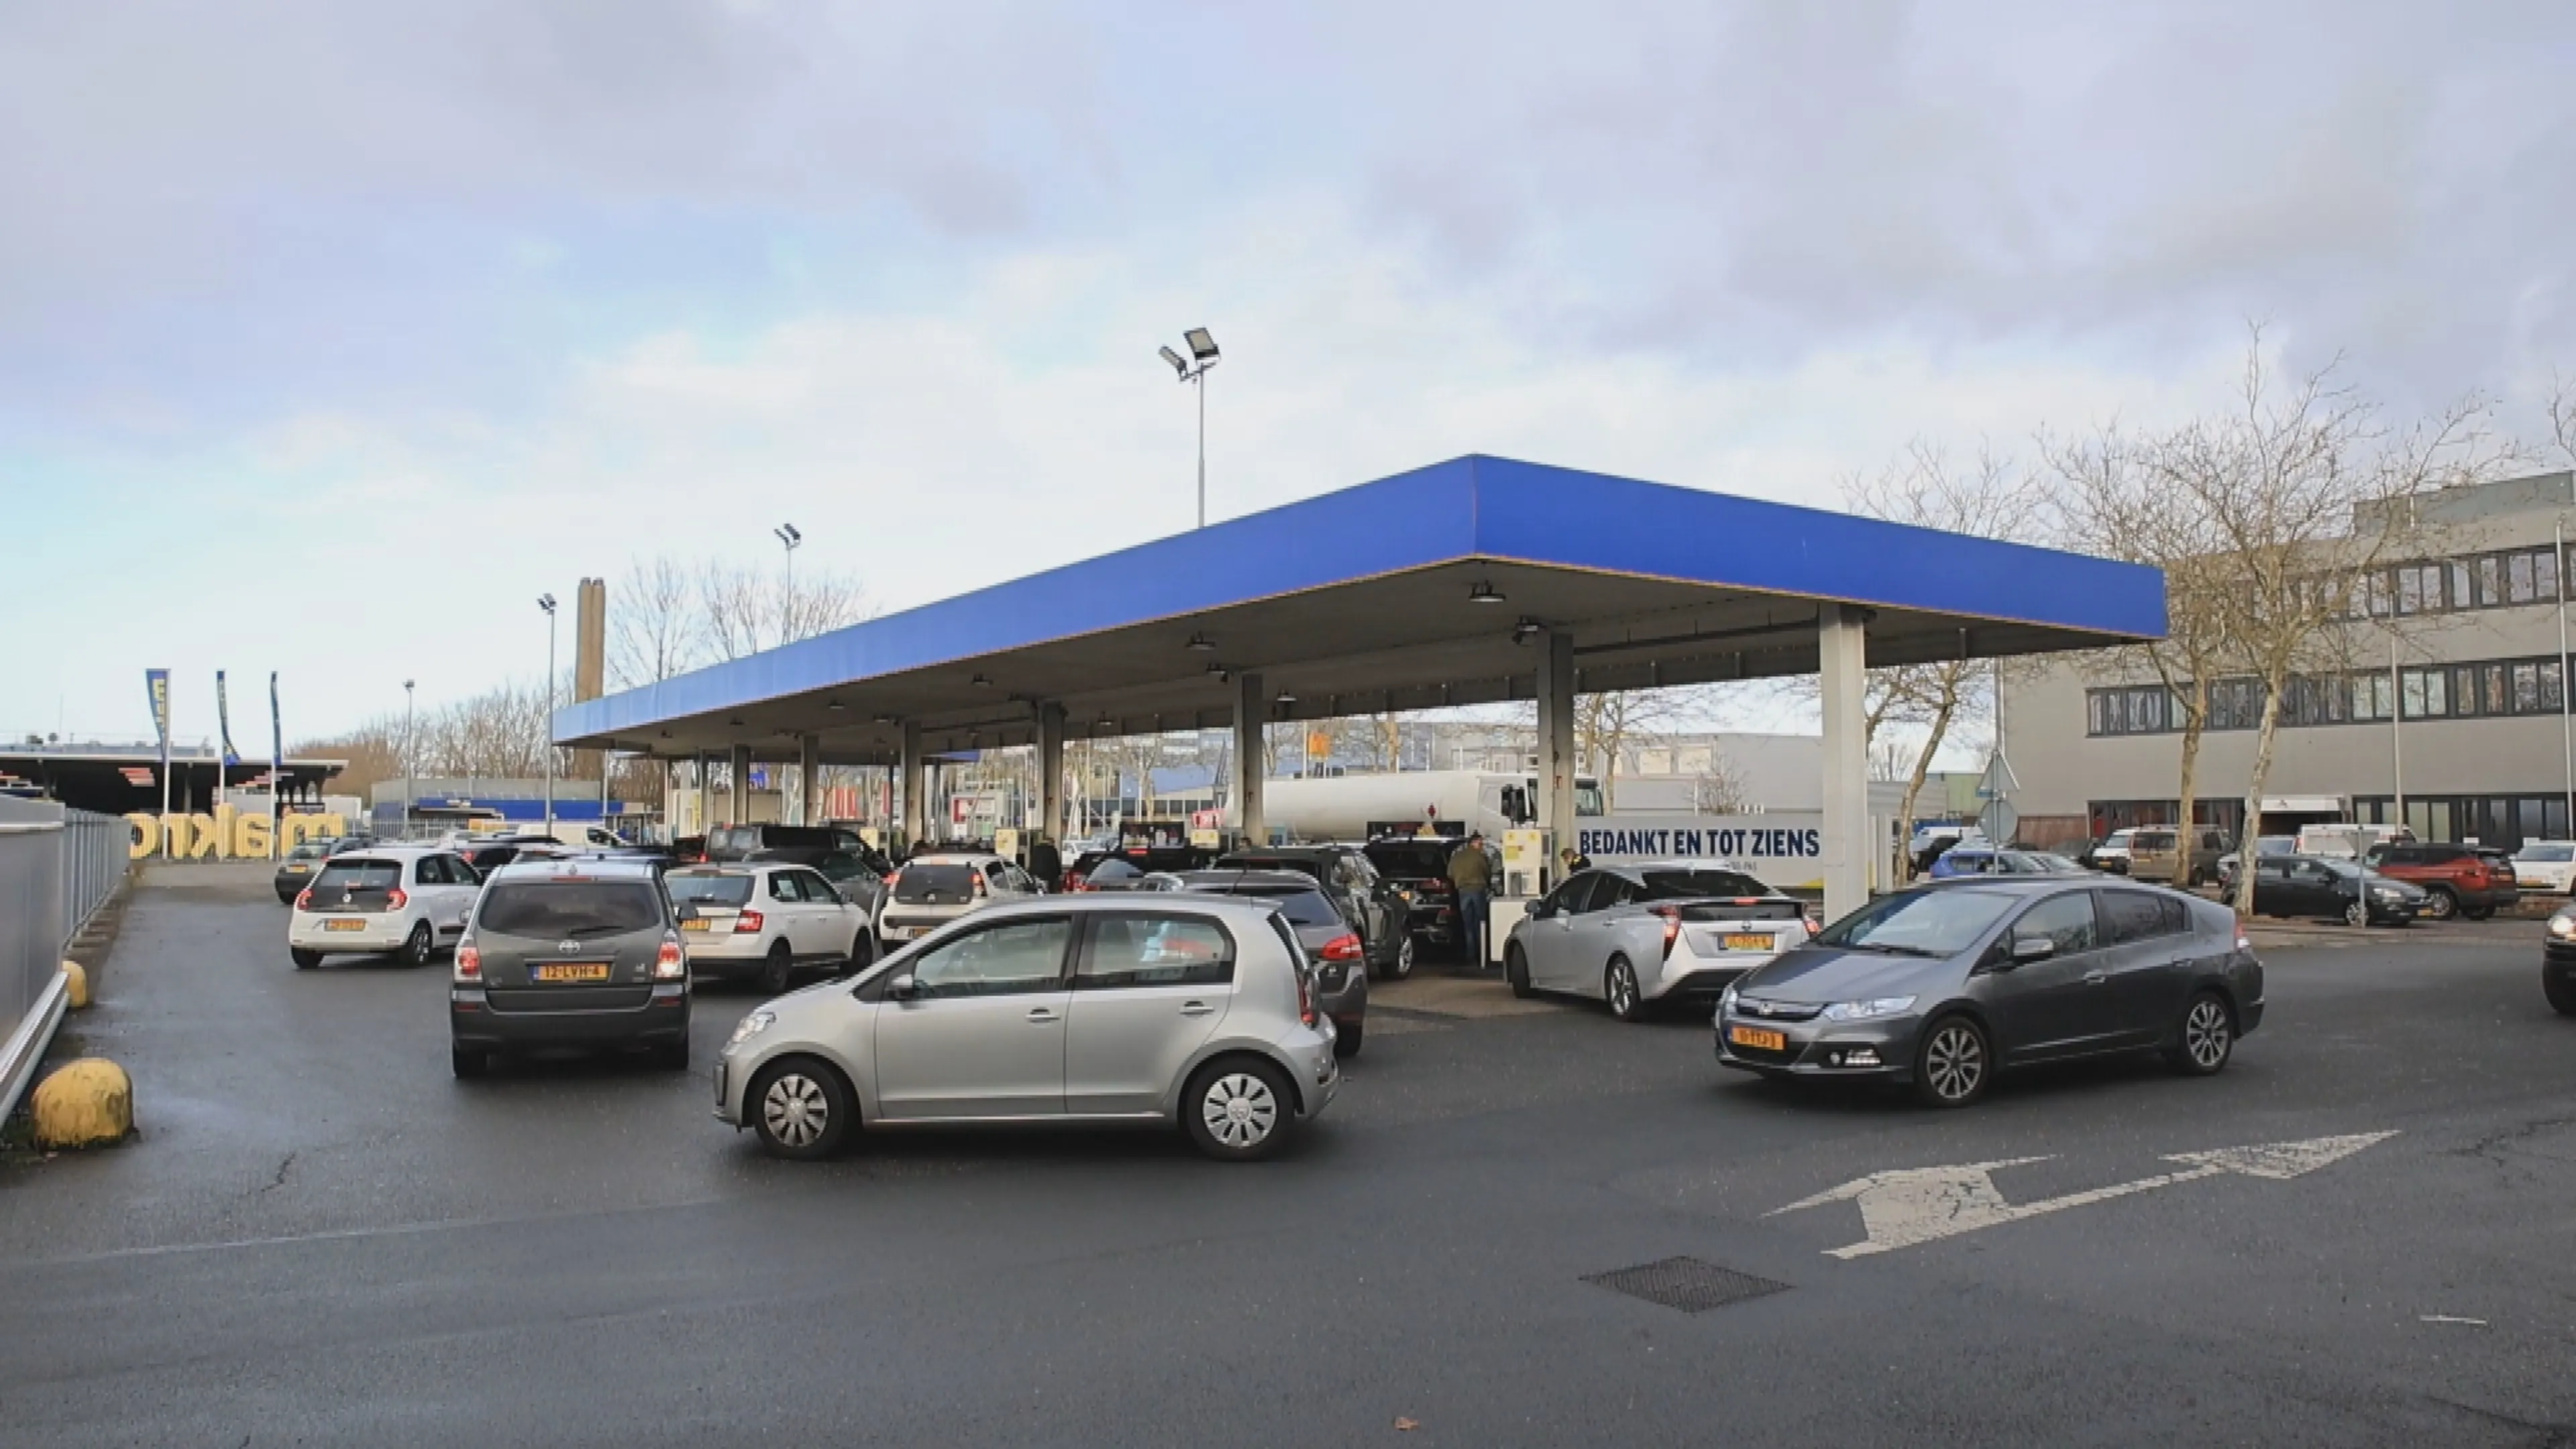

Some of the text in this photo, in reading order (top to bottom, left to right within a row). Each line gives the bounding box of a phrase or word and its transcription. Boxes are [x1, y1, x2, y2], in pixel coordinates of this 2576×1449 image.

[1580, 829, 1820, 857] BEDANKT EN TOT ZIENS
